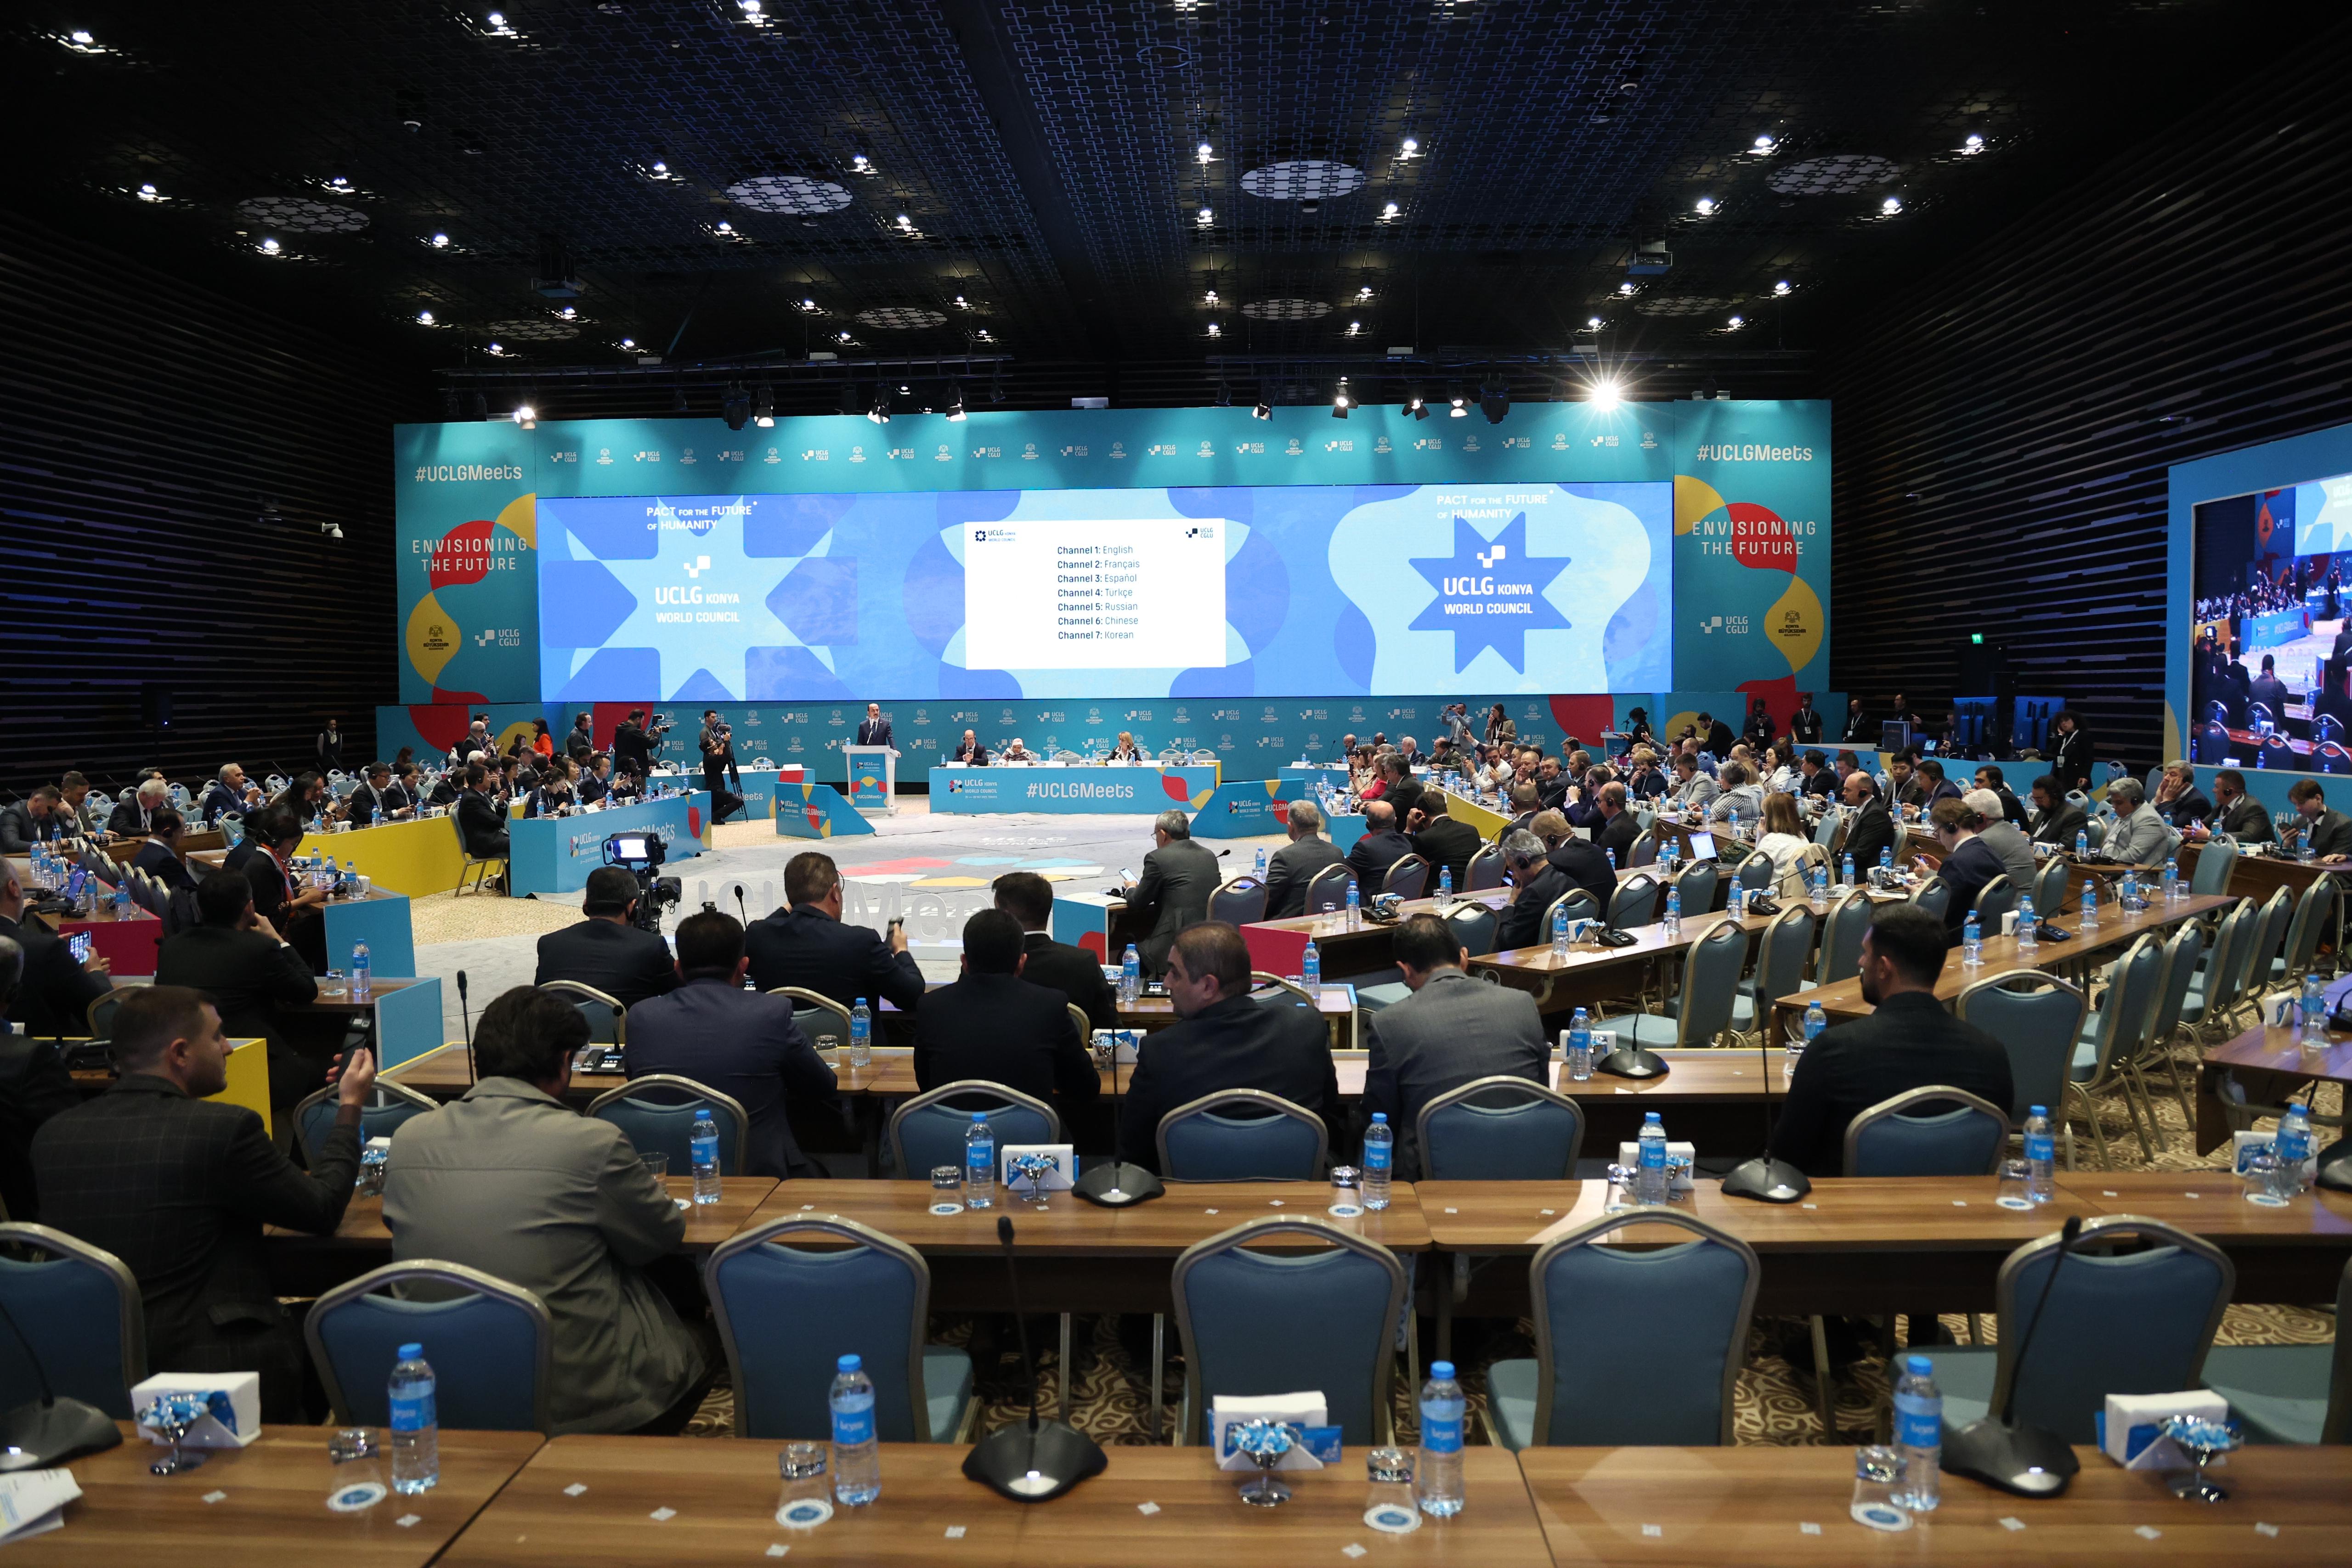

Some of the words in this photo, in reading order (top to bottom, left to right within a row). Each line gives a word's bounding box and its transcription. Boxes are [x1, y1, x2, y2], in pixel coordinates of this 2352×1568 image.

[1697, 445, 1812, 461] #UCLGMeets
[415, 465, 522, 482] #UCLGMeets
[1437, 496, 1467, 505] PACT
[1505, 494, 1547, 504] FUTURE
[647, 507, 676, 516] PACT
[712, 506, 752, 515] FUTURE
[1452, 509, 1512, 519] HUMANITY
[661, 520, 718, 529] HUMANITY
[1692, 521, 1816, 536] ENVISIONING
[413, 537, 527, 553] ENVISIONING
[1057, 546, 1092, 554] Channel
[1103, 546, 1133, 555] English
[1702, 541, 1733, 555] THE
[1739, 541, 1804, 554] FUTURE
[421, 559, 450, 571] THE
[456, 557, 516, 571] FUTURE
[1105, 559, 1140, 570] Français
[1105, 574, 1136, 583] Español
[1443, 577, 1494, 596] UCLG
[1497, 584, 1533, 595] KONYA
[655, 586, 702, 604] UCLG
[706, 593, 740, 604] KONYA
[1105, 588, 1132, 598] Türkçe
[1444, 604, 1483, 615] WORLD
[1487, 603, 1533, 614] COUNCIL
[656, 612, 693, 623] WORLD
[696, 611, 740, 622] COUNCIL
[1058, 617, 1093, 625] Channel
[1105, 616, 1138, 625] Chinese
[1026, 783, 1134, 798] #UCLGMeets
[802, 807, 826, 817] #UCLGMeets
[580, 832, 592, 845] UCLG
